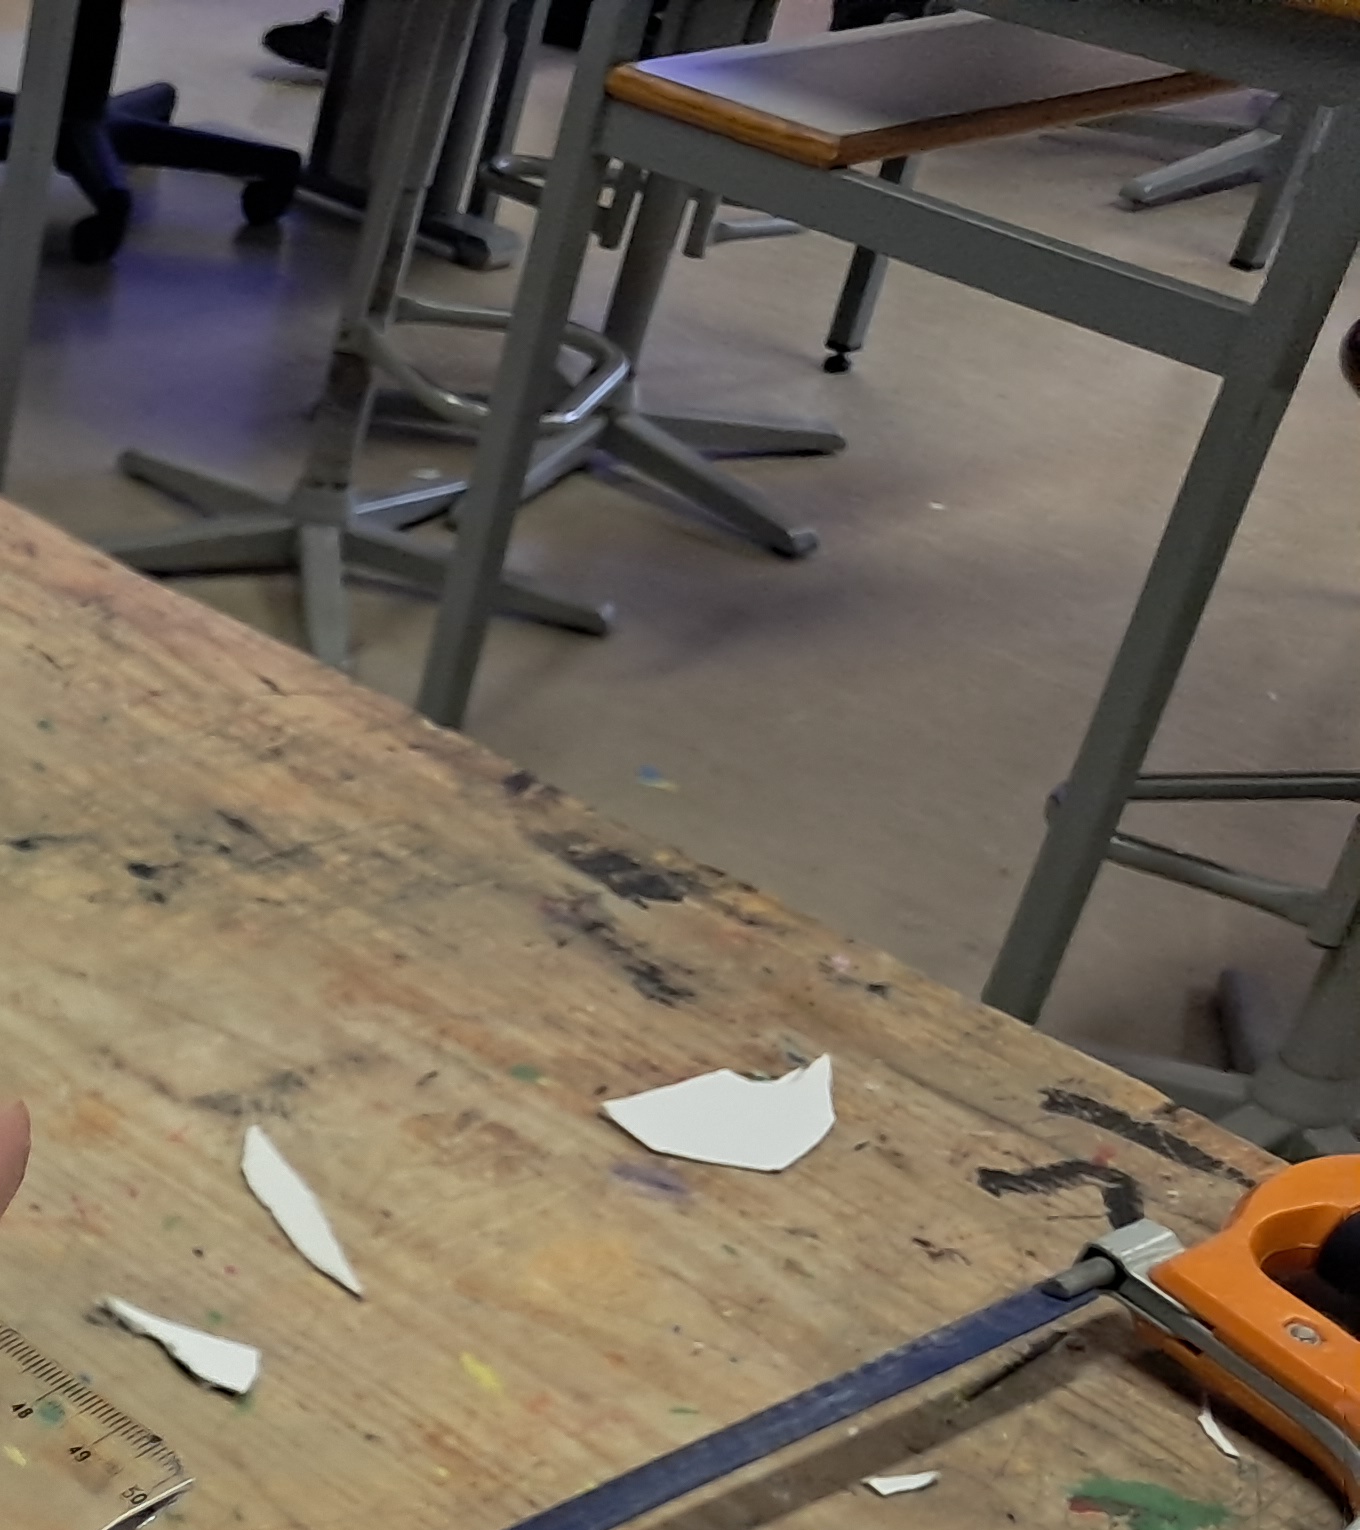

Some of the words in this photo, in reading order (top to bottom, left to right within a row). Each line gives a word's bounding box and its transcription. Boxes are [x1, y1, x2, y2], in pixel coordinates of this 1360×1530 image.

[12, 1403, 33, 1419] 48
[70, 1446, 91, 1462] 49
[122, 1484, 147, 1504] 50
